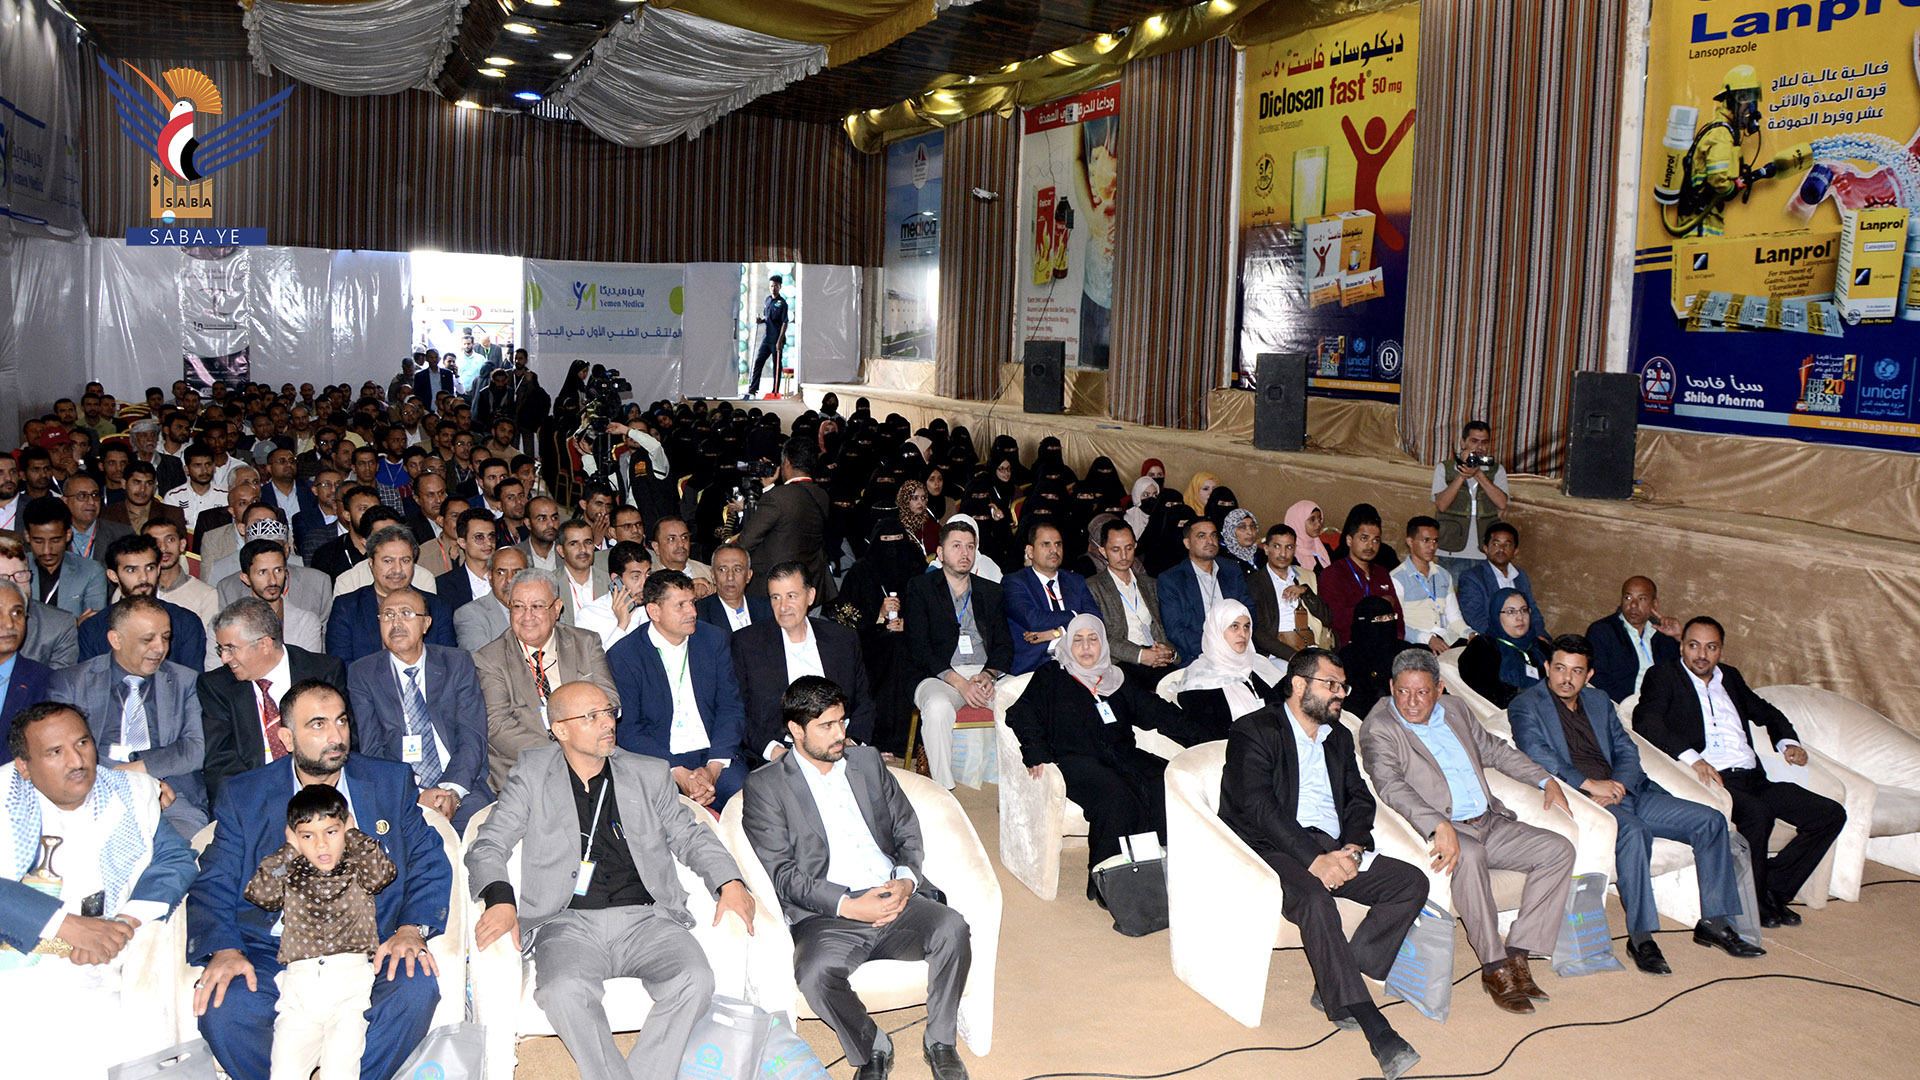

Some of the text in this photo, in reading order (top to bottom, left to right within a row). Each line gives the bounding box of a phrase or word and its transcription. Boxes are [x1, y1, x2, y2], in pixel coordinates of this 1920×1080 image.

[1691, 0, 1920, 44] Lanpr
[1330, 29, 1404, 68] ديكلوسان
[1689, 41, 1757, 59] Lansoprazole
[1771, 60, 1889, 92] فعالية عالية لعلاج
[1259, 86, 1324, 120] Diclosan
[1372, 76, 1387, 94] 50
[1388, 80, 1402, 94] mg
[1813, 86, 1854, 104] المعدة
[1856, 82, 1887, 100] قرحة
[1767, 105, 1884, 131] عشر وفرط الحموضة
[1259, 163, 1264, 175] 5
[1662, 154, 1676, 188] Lanprol
[900, 219, 937, 239] medica
[1860, 219, 1904, 232] Lanprol
[1755, 240, 1831, 266] Lanprol
[1779, 268, 1806, 276] treatment
[600, 285, 645, 297] يمن ميديكا
[600, 300, 645, 308] Yemen Medica
[566, 327, 585, 341] في
[586, 325, 605, 338] الأول
[607, 327, 640, 342] الطبي
[1825, 378, 1846, 395] 20
[1862, 384, 1908, 400] unicef
[1684, 391, 1764, 408] Shiba Pharma
[1808, 392, 1843, 405] BEST
